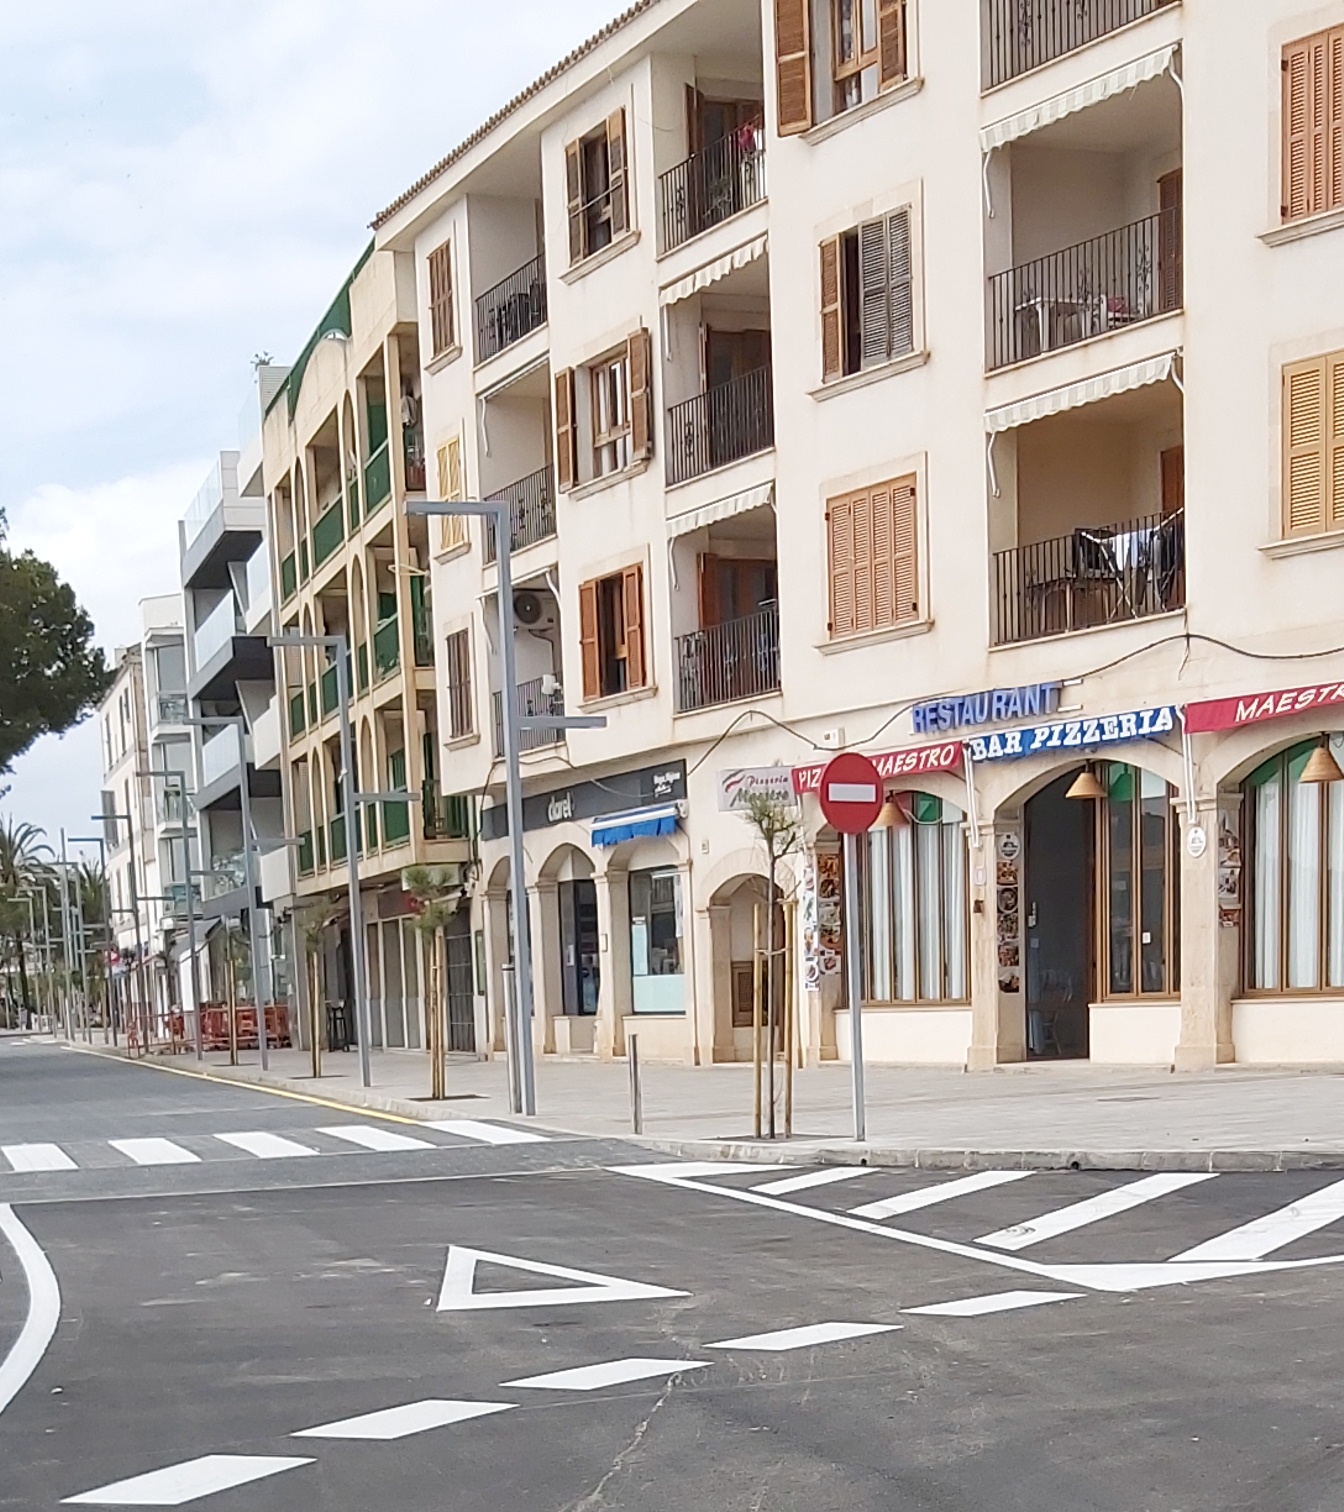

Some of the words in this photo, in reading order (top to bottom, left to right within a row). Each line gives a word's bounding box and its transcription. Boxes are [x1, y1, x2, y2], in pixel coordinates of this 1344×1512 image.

[912, 680, 1062, 733] RESTAURANT
[970, 732, 1023, 760] BAR
[1030, 707, 1174, 747] PIZZERIA
[872, 744, 955, 779] MAESTRO
